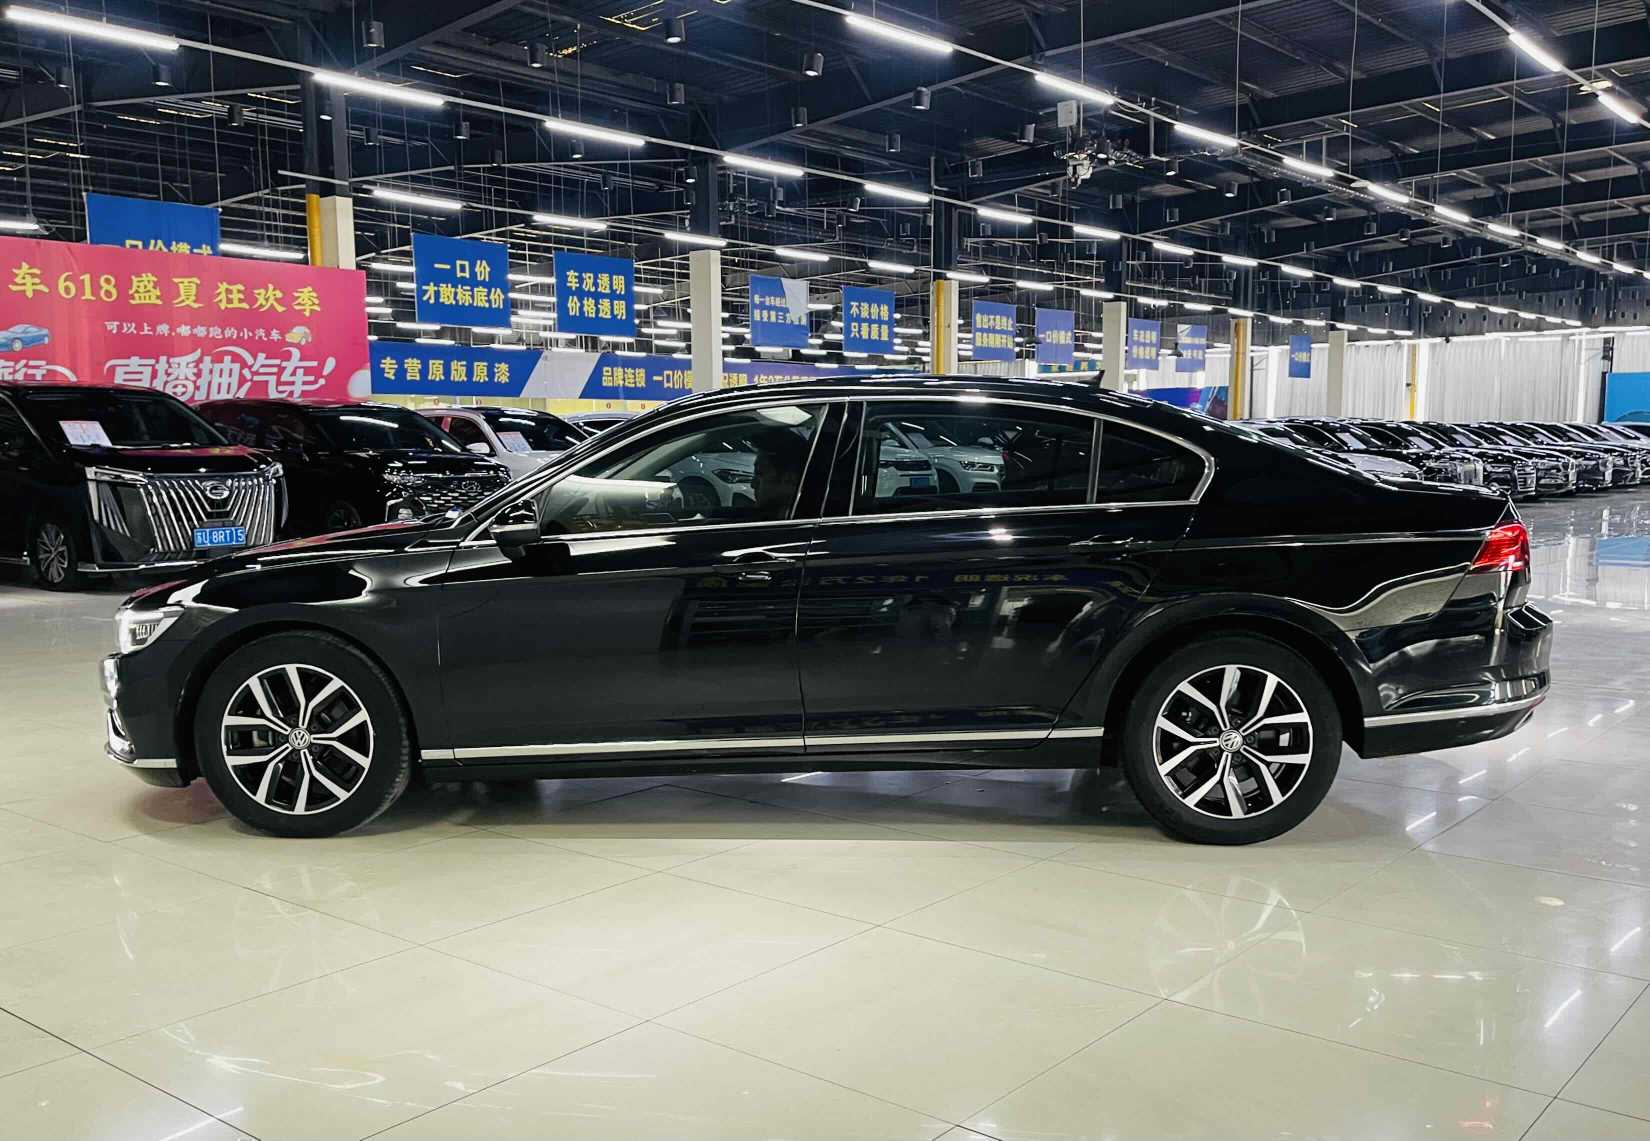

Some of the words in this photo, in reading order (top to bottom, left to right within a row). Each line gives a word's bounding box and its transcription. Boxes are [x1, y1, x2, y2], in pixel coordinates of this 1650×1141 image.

[433, 259, 492, 282] 一口价
[566, 270, 625, 294] 车况透明
[422, 282, 505, 310] 才敢标底价
[567, 297, 627, 320] 价格透明
[850, 301, 890, 321] 不谈价格
[850, 322, 890, 341] 只看质量
[380, 356, 511, 384] 专营原版原漆
